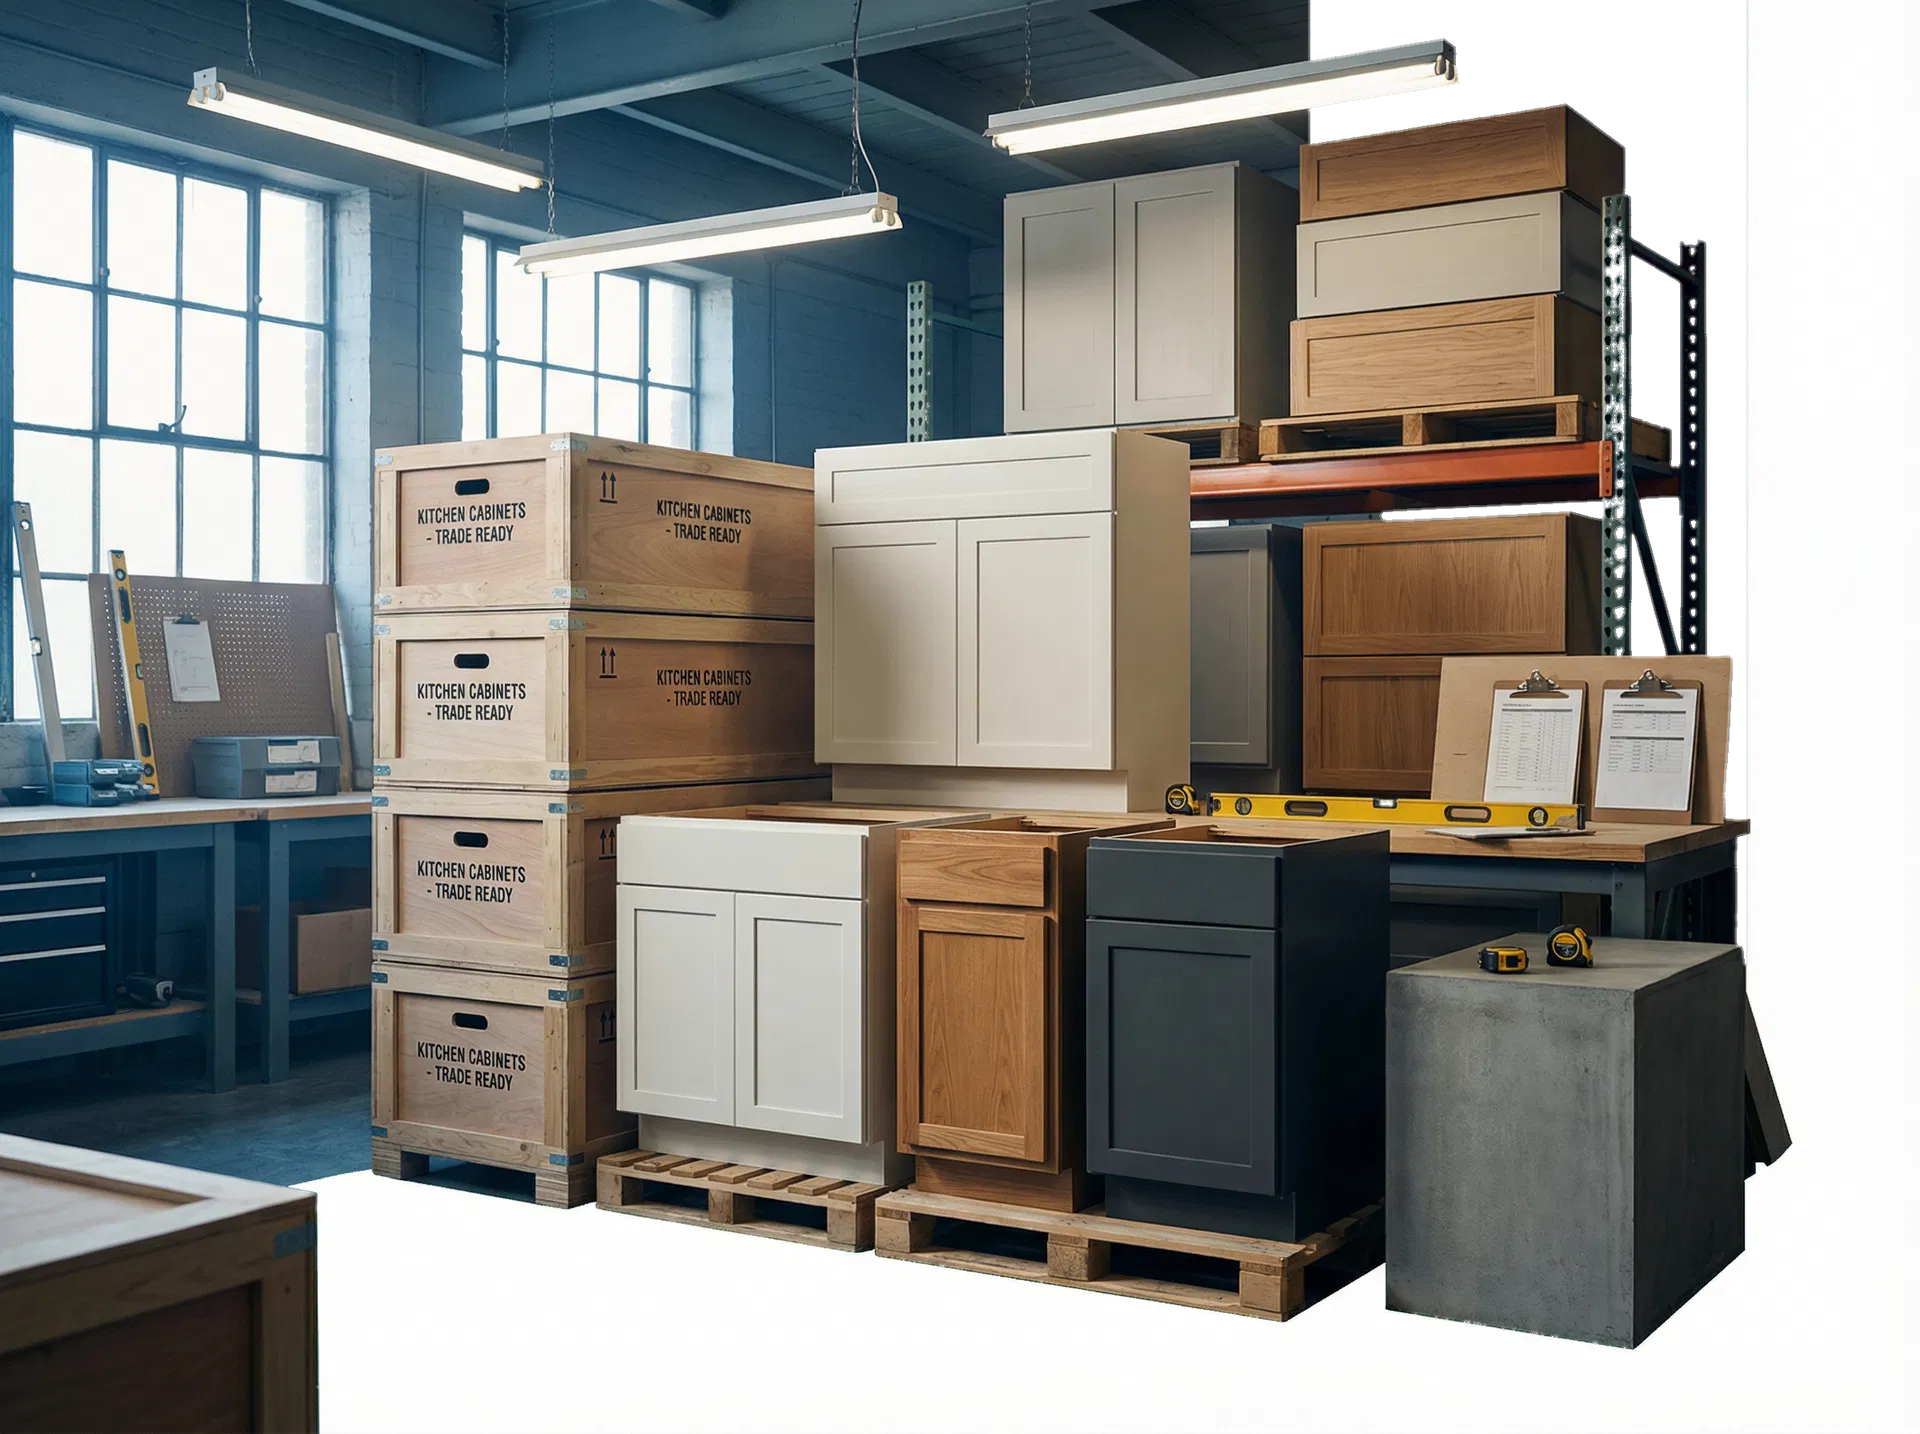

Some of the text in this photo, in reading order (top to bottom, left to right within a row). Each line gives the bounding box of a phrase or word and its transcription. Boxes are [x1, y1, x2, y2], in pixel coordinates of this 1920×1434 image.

[417, 501, 527, 525] KITCHEN CABINETS
[656, 499, 752, 526] KITCHEN CABINETS
[434, 527, 473, 545] TRADE
[475, 524, 514, 543] READY
[673, 522, 707, 542] TRADE
[708, 525, 742, 544] READY
[656, 669, 752, 687] KITCHEN CABINETS
[417, 682, 527, 700] KITCHEN CABINETS
[673, 690, 707, 707] TRADE
[708, 689, 743, 707] READY
[434, 704, 473, 721] TRADE
[475, 704, 514, 721] READY
[417, 860, 526, 884] KITCHEN CABINETS
[434, 882, 472, 902] TRADE
[474, 885, 514, 904] READY
[417, 1041, 526, 1072] KITCHEN CABINETS
[434, 1064, 472, 1086] TRADE
[474, 1070, 514, 1092] READY
